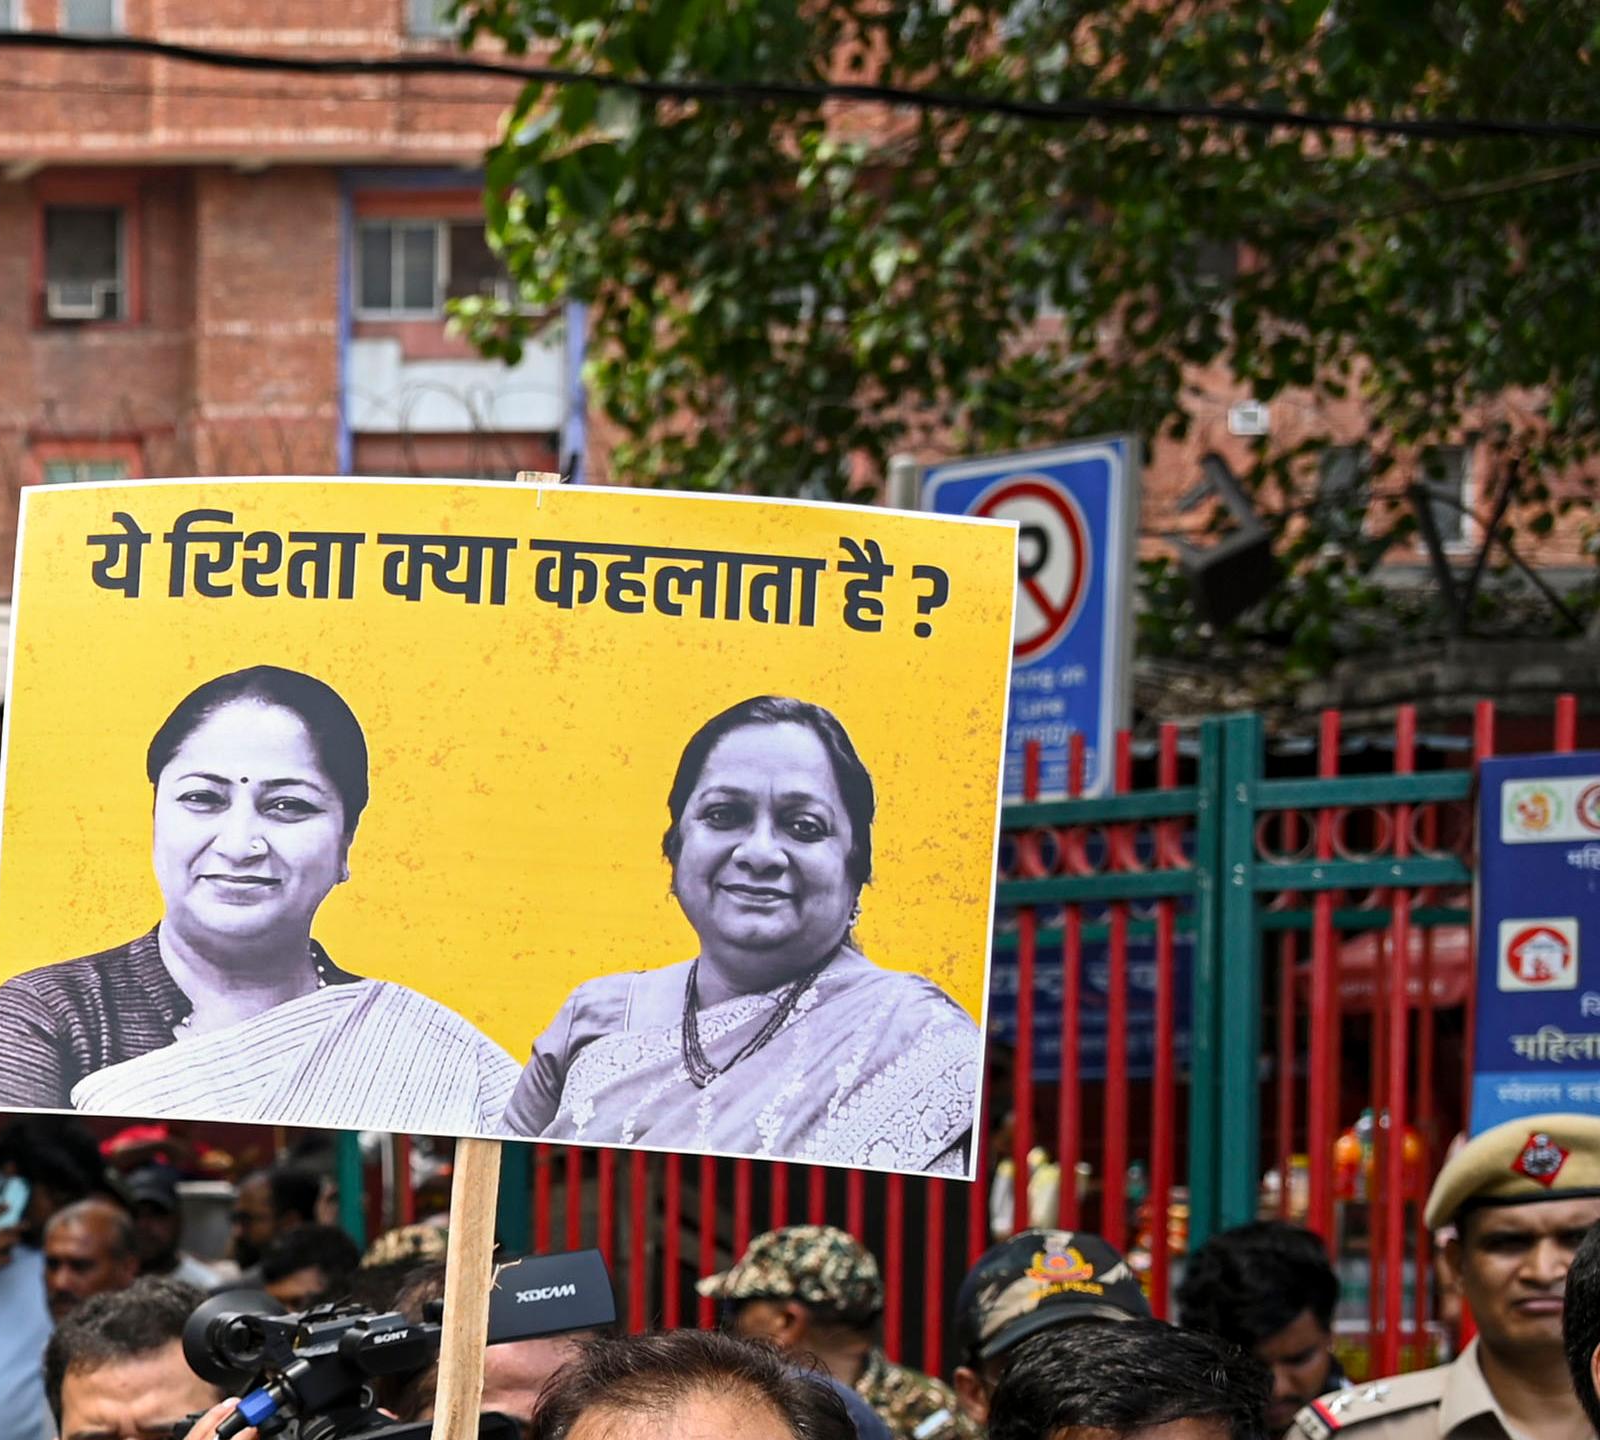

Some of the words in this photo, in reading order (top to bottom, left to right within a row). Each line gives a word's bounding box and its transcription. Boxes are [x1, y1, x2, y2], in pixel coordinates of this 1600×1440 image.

[85, 511, 153, 600] ये
[162, 508, 367, 601] रिश्ता
[376, 532, 519, 607] क्या
[529, 537, 828, 628] कहलाता
[836, 536, 895, 633] है
[910, 563, 950, 638] ?
[514, 1283, 576, 1304] XDCAM
[373, 1328, 409, 1345] SONY
